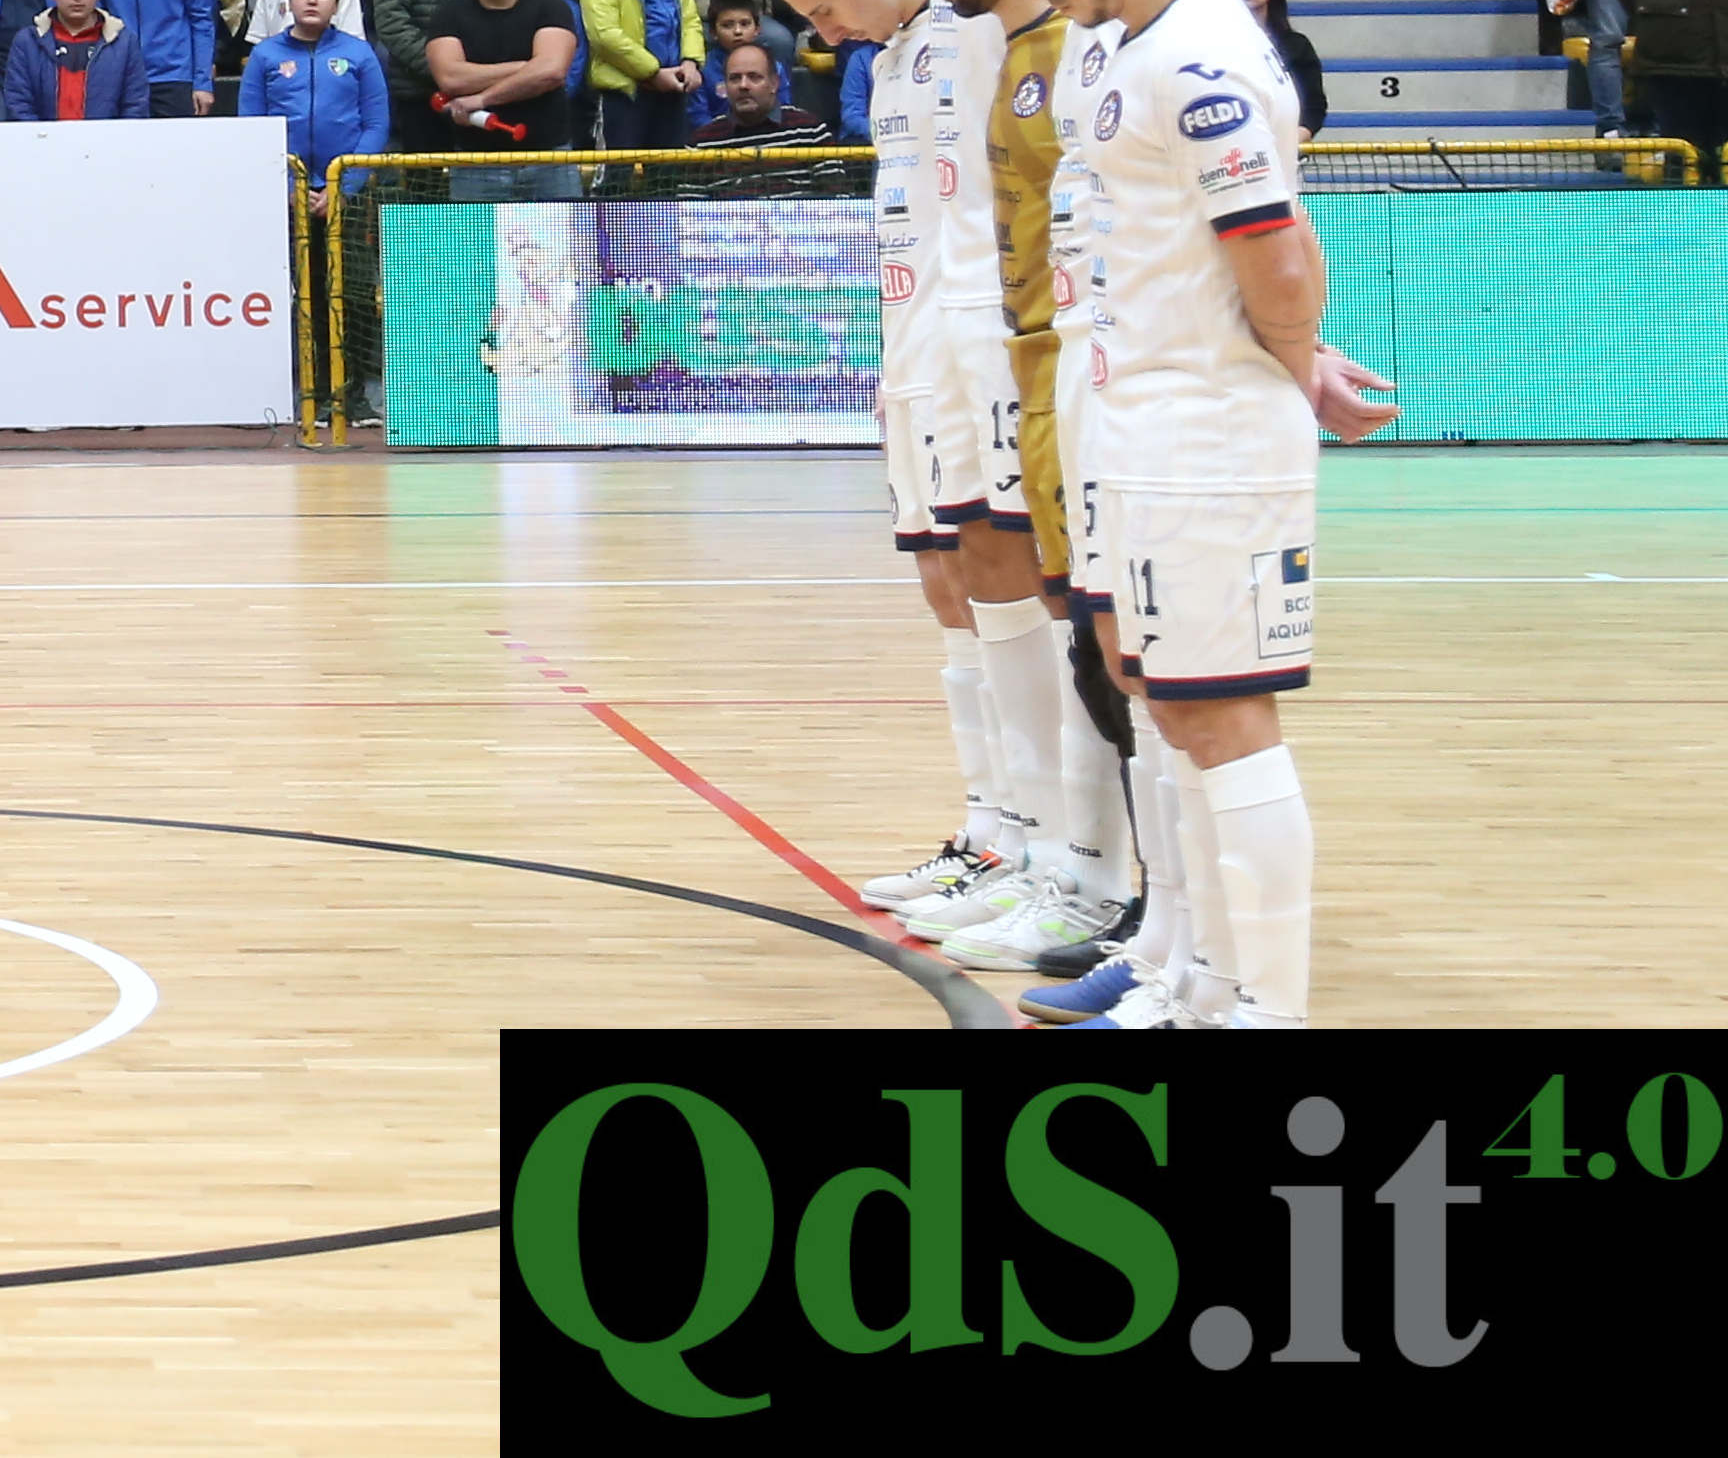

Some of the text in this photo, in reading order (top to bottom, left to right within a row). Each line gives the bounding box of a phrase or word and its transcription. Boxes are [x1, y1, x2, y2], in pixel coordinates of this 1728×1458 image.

[1381, 77, 1400, 98] 3
[1183, 100, 1244, 134] FELDI
[39, 281, 273, 329] service
